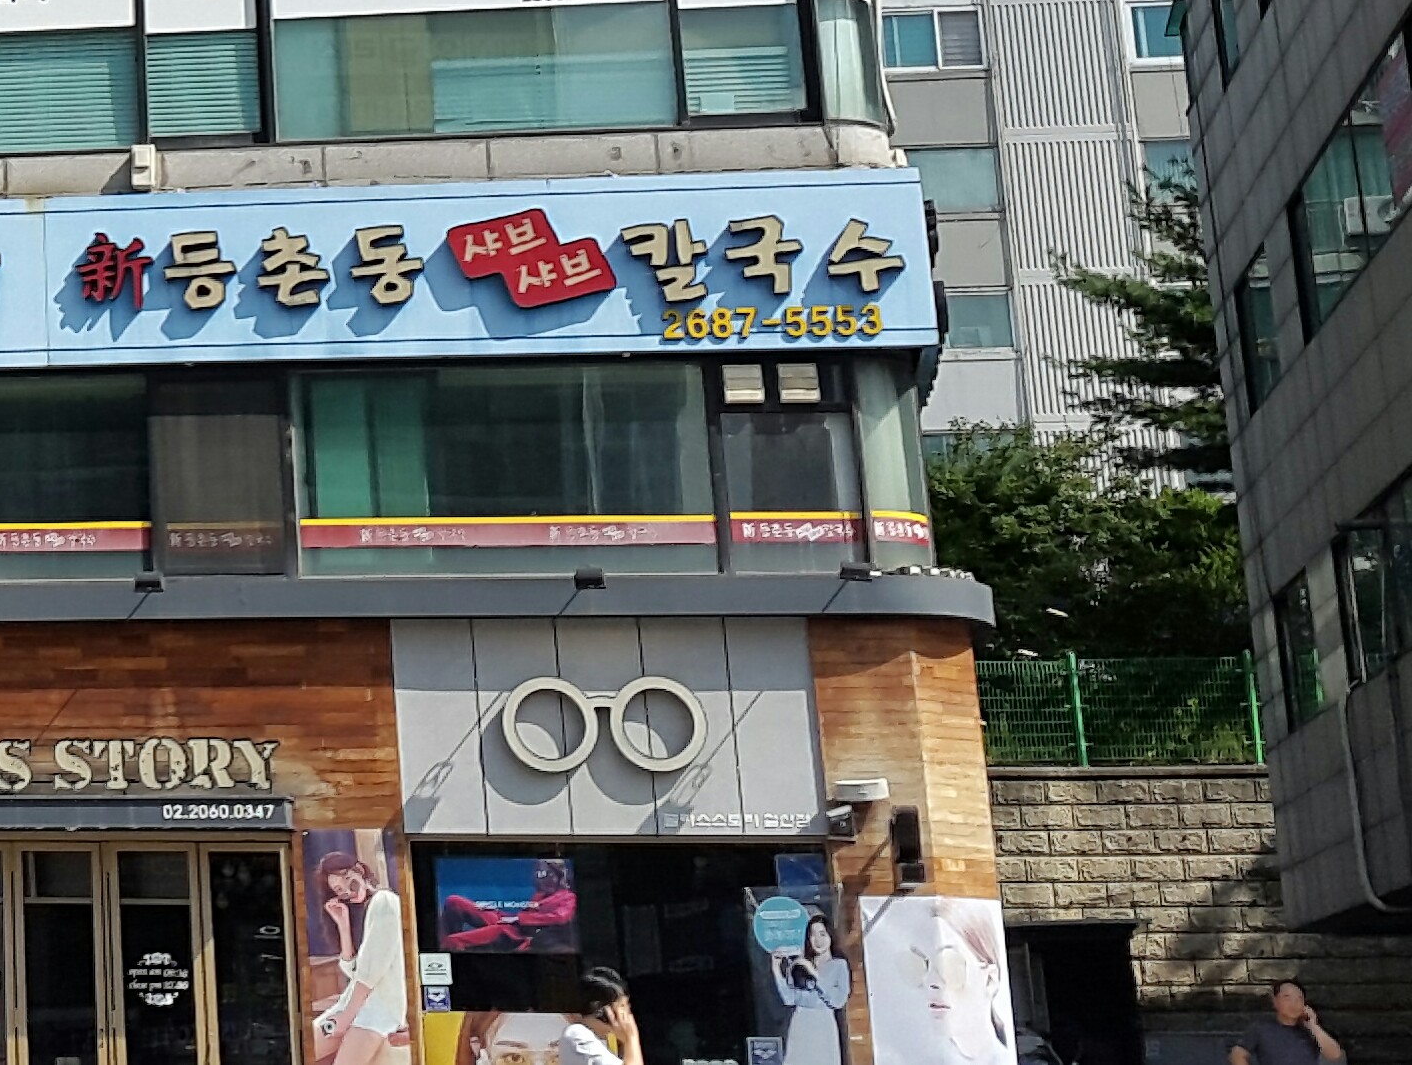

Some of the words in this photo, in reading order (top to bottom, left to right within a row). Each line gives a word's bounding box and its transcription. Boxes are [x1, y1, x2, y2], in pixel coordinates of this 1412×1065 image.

[461, 218, 550, 265] 샤브
[621, 216, 907, 305] 칼국수
[163, 223, 424, 312] 등촌동
[515, 252, 602, 297] 샤브
[662, 304, 885, 343] 2687-5553
[54, 738, 280, 792] STORY
